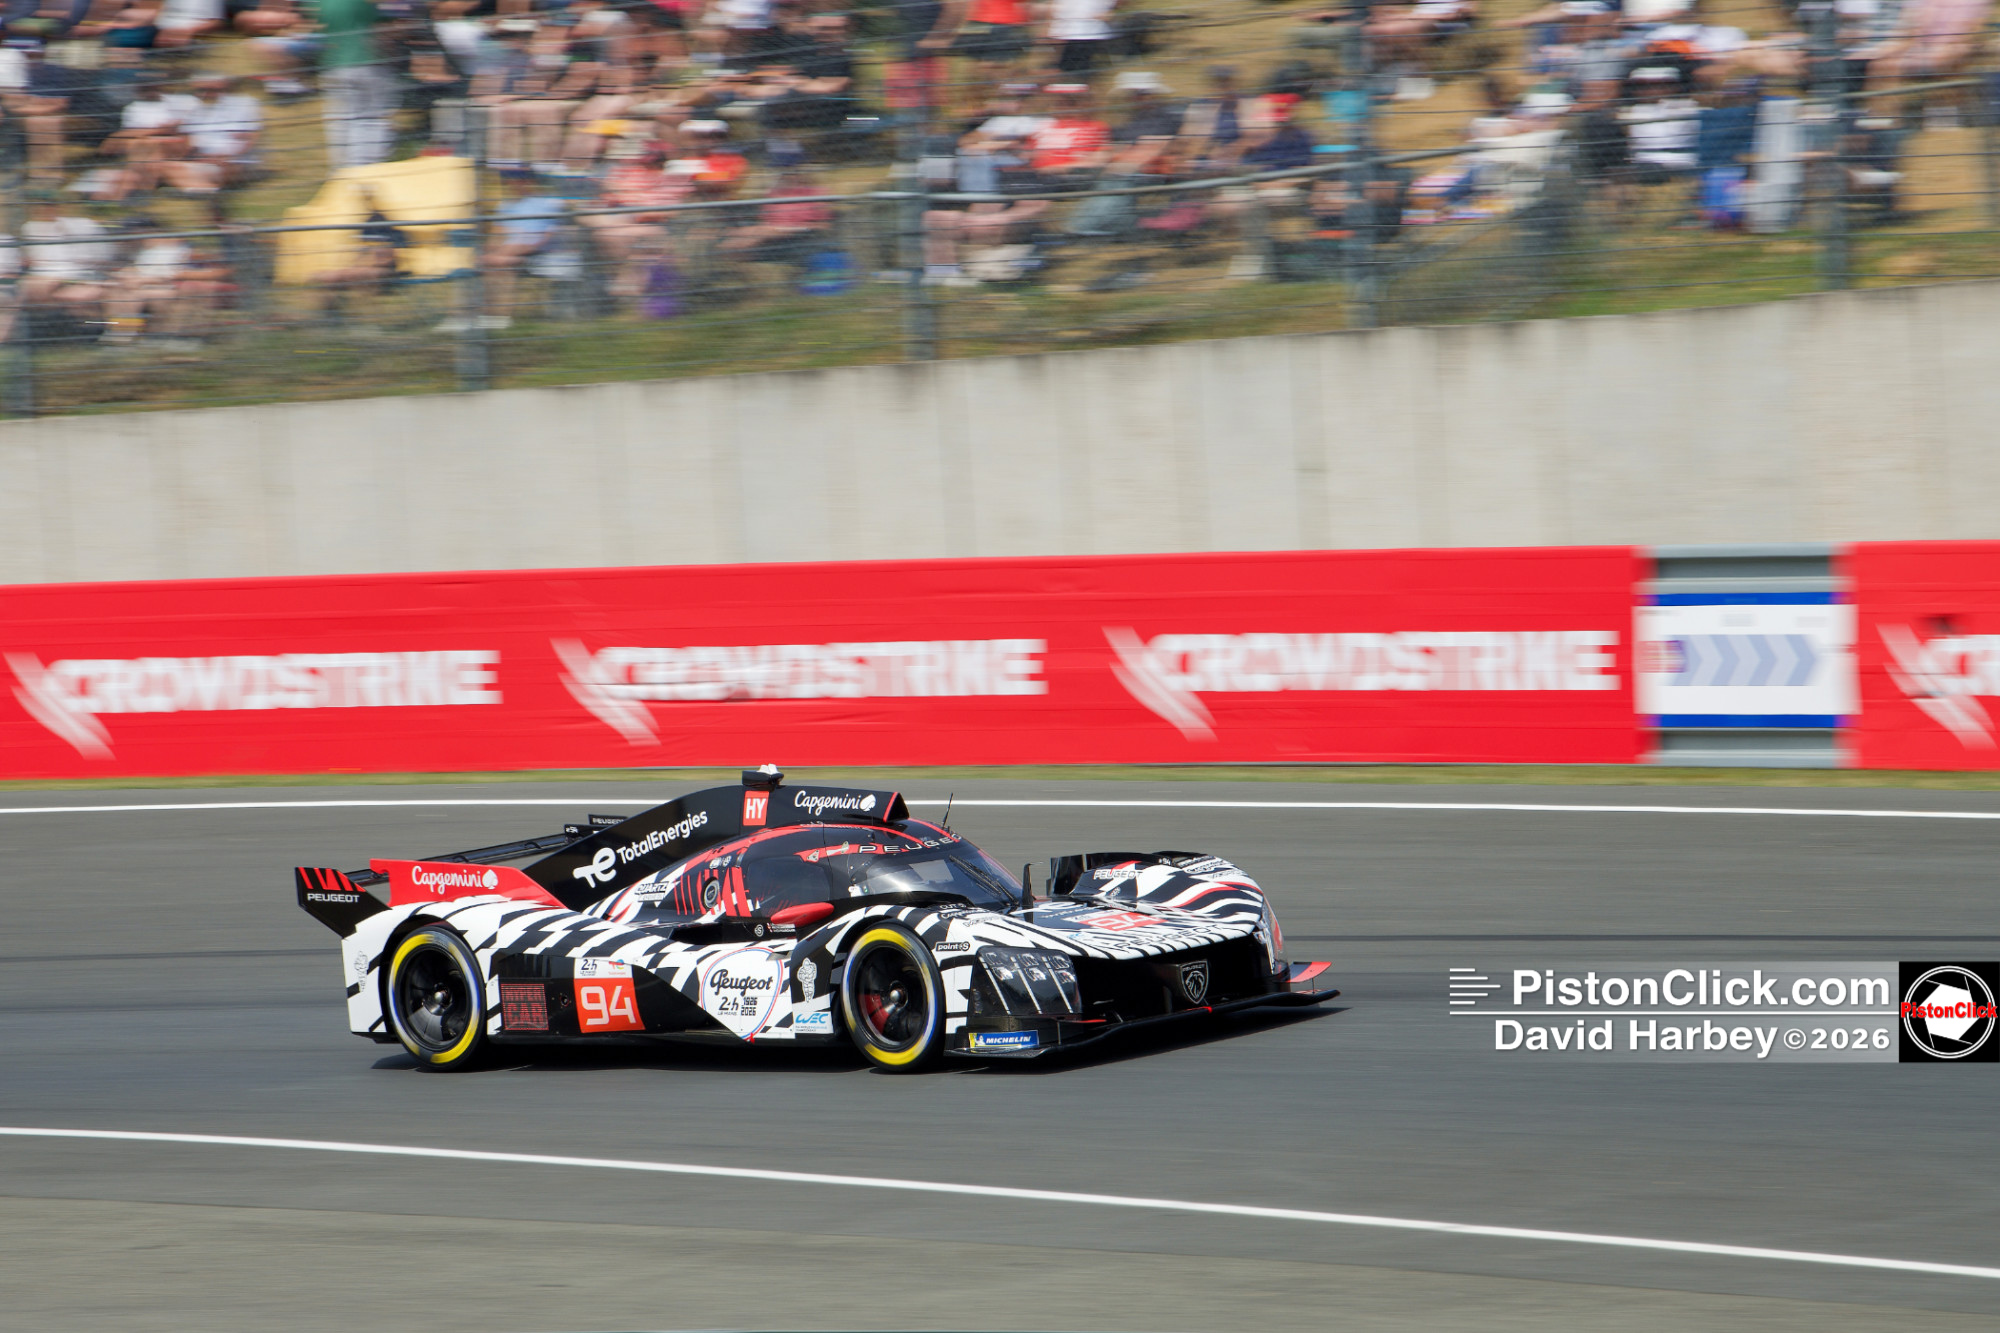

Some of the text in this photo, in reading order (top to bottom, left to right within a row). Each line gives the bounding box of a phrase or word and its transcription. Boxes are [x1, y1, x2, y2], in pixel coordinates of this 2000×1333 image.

[592, 639, 1048, 701] CROWDSTRIKE
[1146, 631, 1620, 692] CROWDSTRIKE
[44, 650, 502, 713] CROWDSTRIKE
[745, 798, 766, 819] HY
[794, 790, 861, 816] Capgemini
[616, 811, 708, 864] TotalEnergies
[412, 865, 483, 895] Capgemini
[1093, 869, 1143, 880] PEUGEOT
[307, 893, 360, 903] PEUGEOT
[710, 969, 773, 996] Peugeot
[580, 985, 637, 1025] 94
[740, 1006, 756, 1016] 2026
[795, 1013, 828, 1024] WEC
[986, 1035, 1031, 1044] MICHELIN
